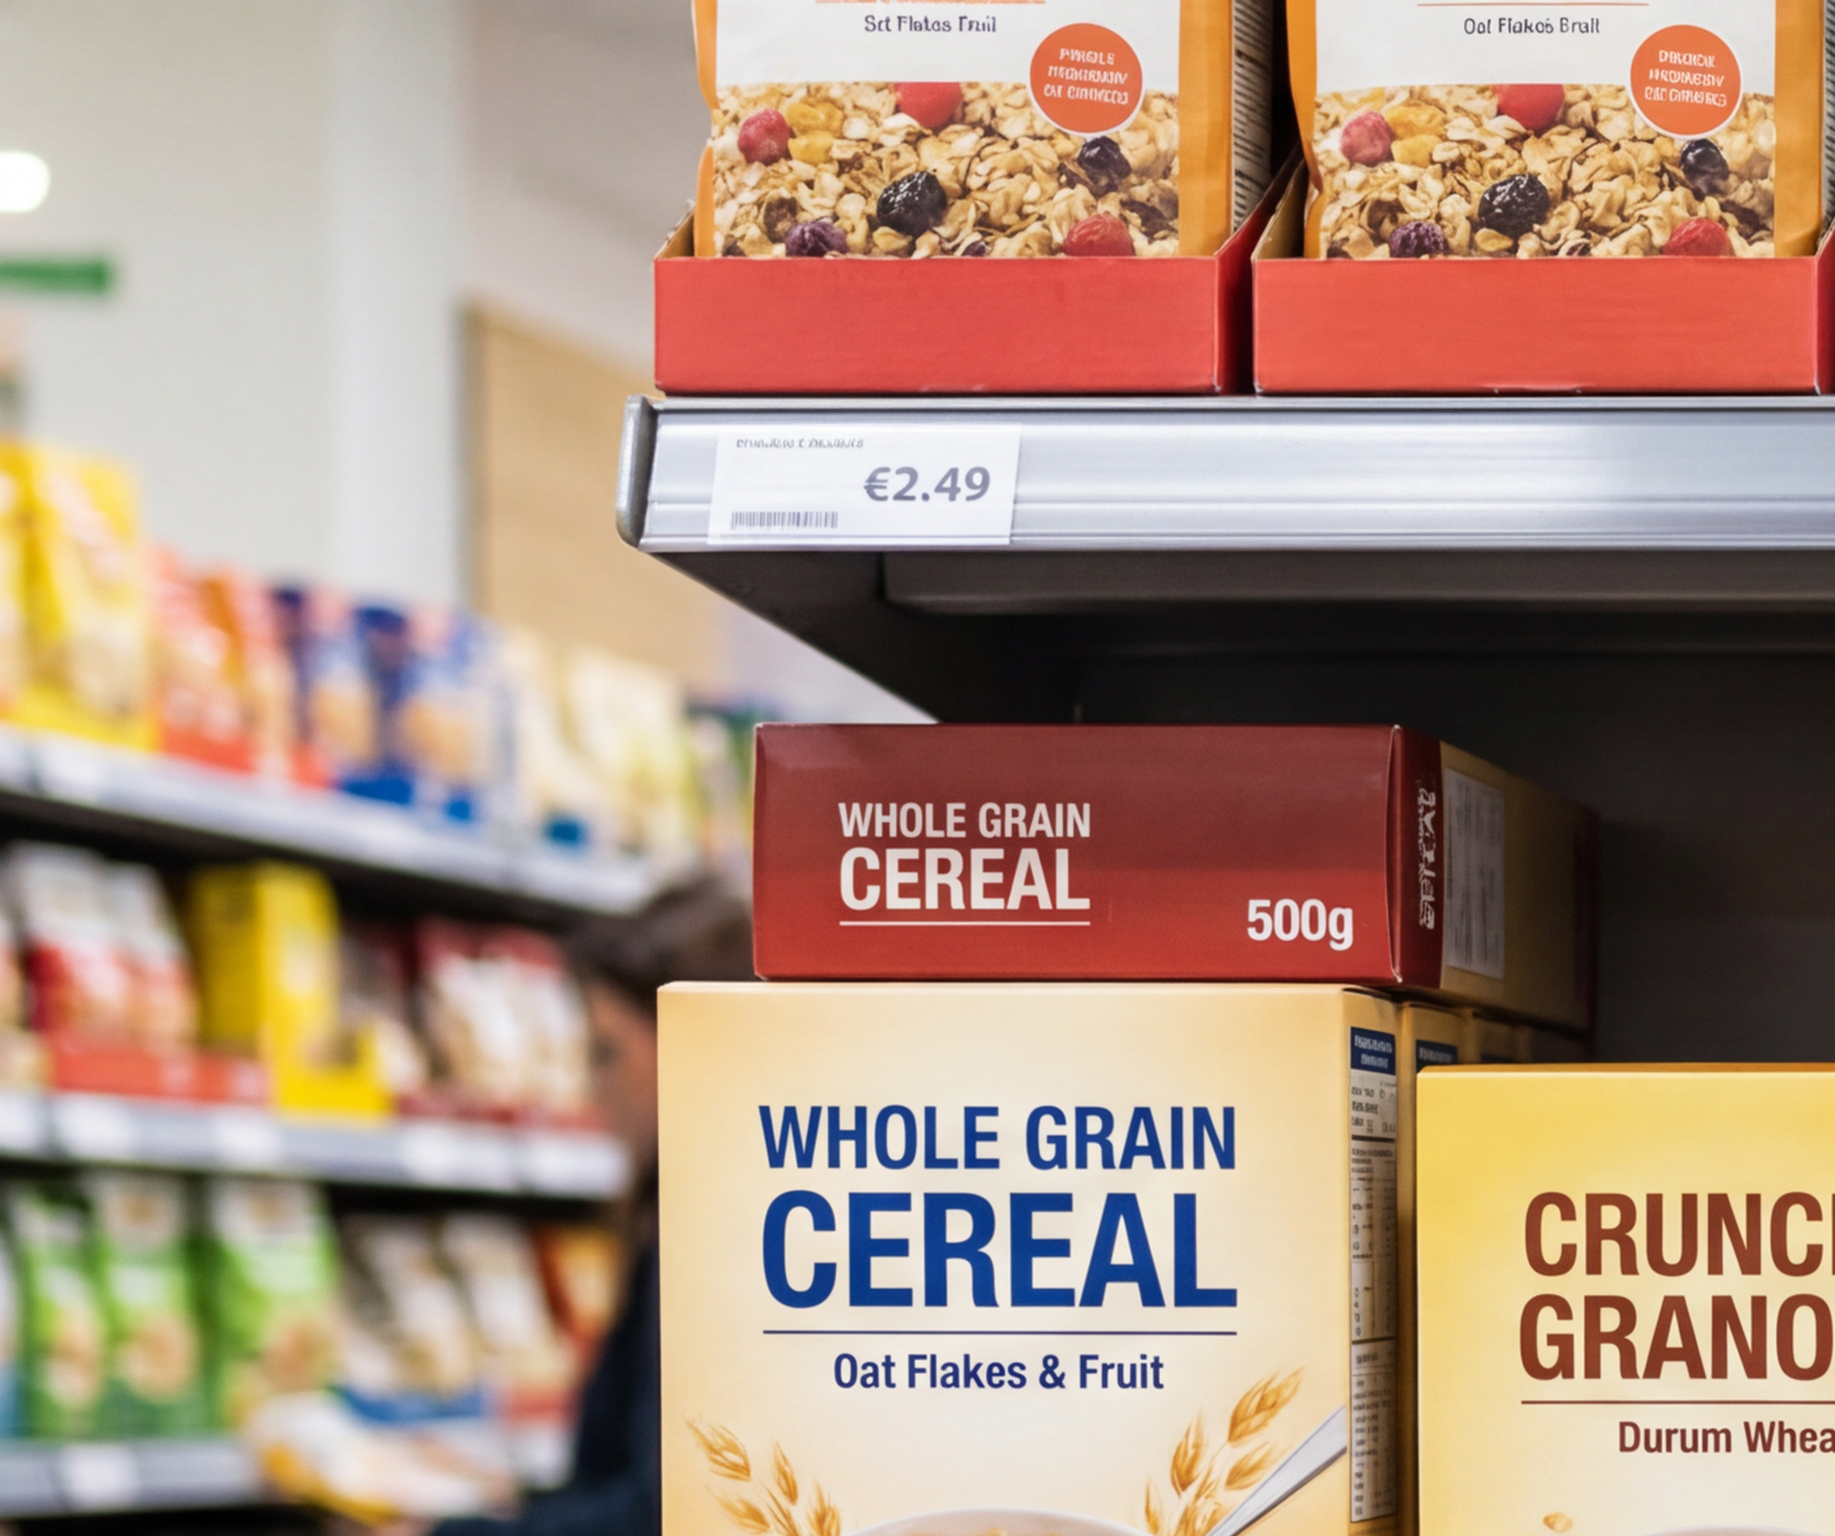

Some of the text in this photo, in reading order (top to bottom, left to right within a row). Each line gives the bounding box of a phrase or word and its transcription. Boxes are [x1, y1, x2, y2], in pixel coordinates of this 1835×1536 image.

[864, 466, 991, 502] €2.49
[839, 802, 1091, 839] WHOLE GRAIN
[839, 848, 1091, 912] CEREAL
[1247, 899, 1354, 951] 500g
[759, 1104, 1236, 1170] WHOLE GRAIN
[763, 1189, 1238, 1308] CEREAL
[834, 1352, 1164, 1390] Oat Flakes & Fruit
[1618, 1420, 1732, 1453] Durum
